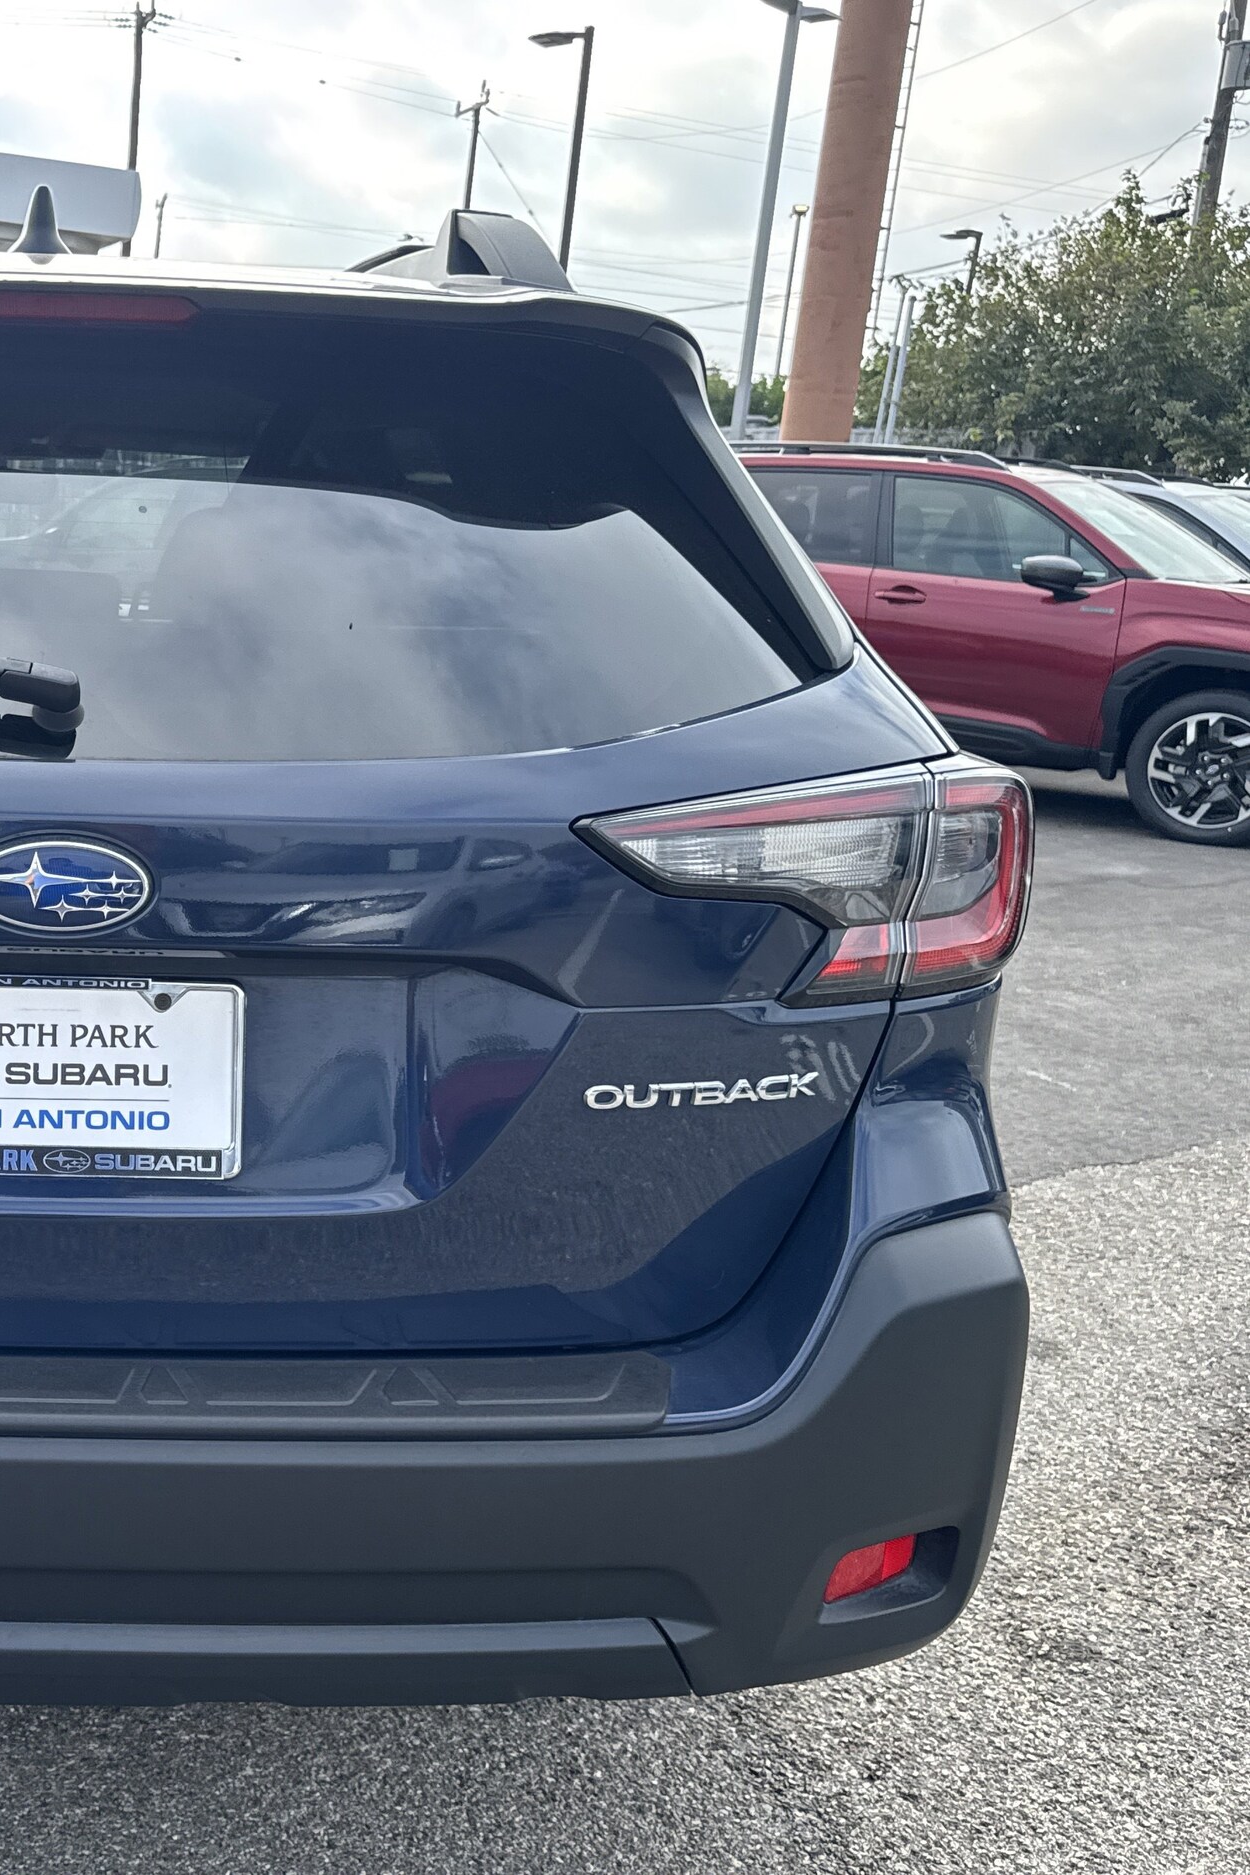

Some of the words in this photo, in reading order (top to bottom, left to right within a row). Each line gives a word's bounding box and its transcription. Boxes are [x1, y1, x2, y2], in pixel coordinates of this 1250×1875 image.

[22, 978, 146, 988] ANTONIO
[70, 1024, 159, 1049] PARK
[5, 1062, 170, 1087] SUBARU
[583, 1071, 820, 1110] OUTBACK
[13, 1110, 171, 1131] ANTONIO
[94, 1153, 218, 1173] SUBARU
